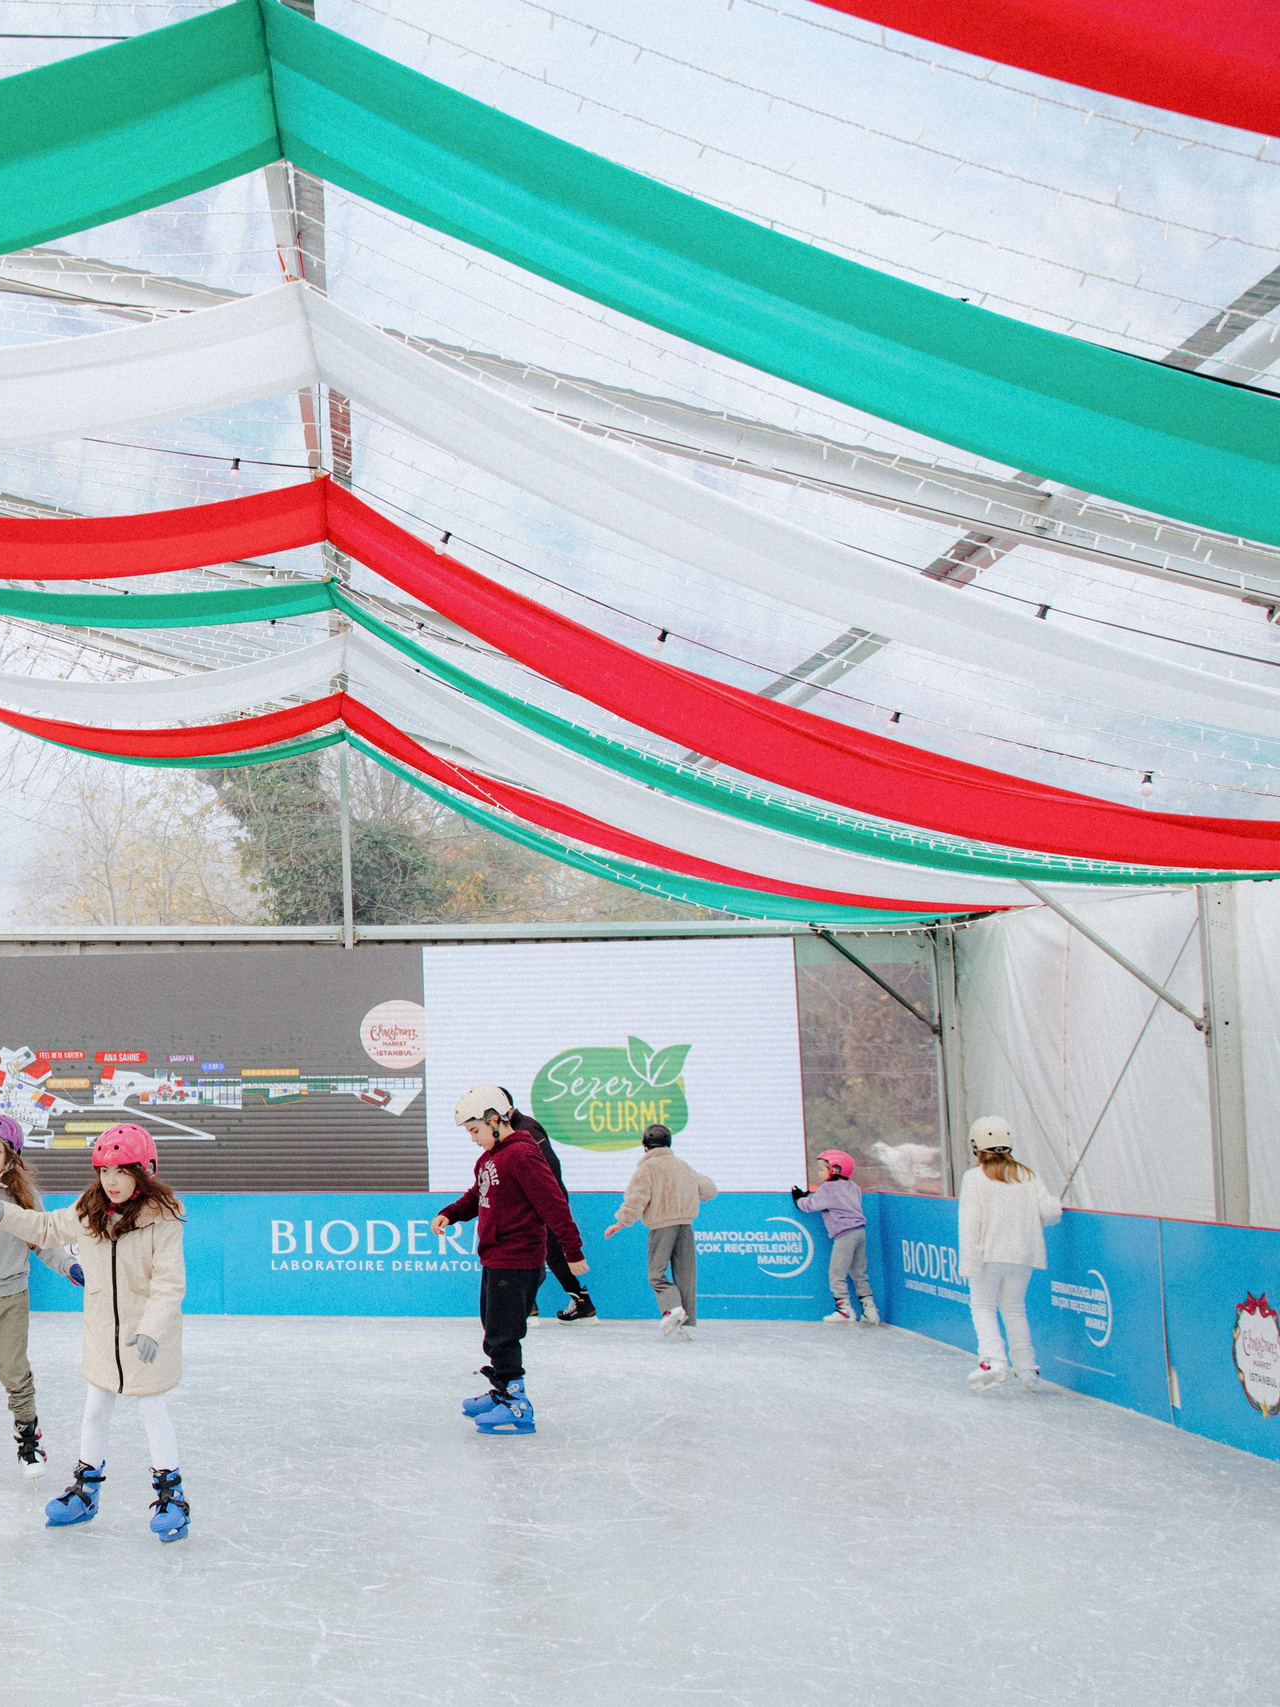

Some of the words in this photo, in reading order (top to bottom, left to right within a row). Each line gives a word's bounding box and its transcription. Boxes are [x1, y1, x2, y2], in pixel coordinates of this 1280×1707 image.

[370, 1024, 419, 1041] Christmas
[39, 1052, 51, 1060] FEEL
[51, 1052, 63, 1060] REAL
[63, 1051, 84, 1059] GARDEN
[103, 1053, 118, 1062] ANA
[118, 1053, 141, 1062] SAHNE
[542, 1055, 645, 1121] Sezer
[589, 1099, 672, 1133] GURME
[271, 1220, 480, 1255] BIODER
[694, 1231, 802, 1242] RMATOLOGLARIN
[696, 1243, 722, 1255] ÇOK
[724, 1242, 803, 1255] REÇETELEDİĞİ
[271, 1259, 385, 1271] LABORATOIRE
[392, 1259, 482, 1272] DERMATOL
[901, 1239, 969, 1287] BIODER
[1253, 1359, 1272, 1370] MARKET
